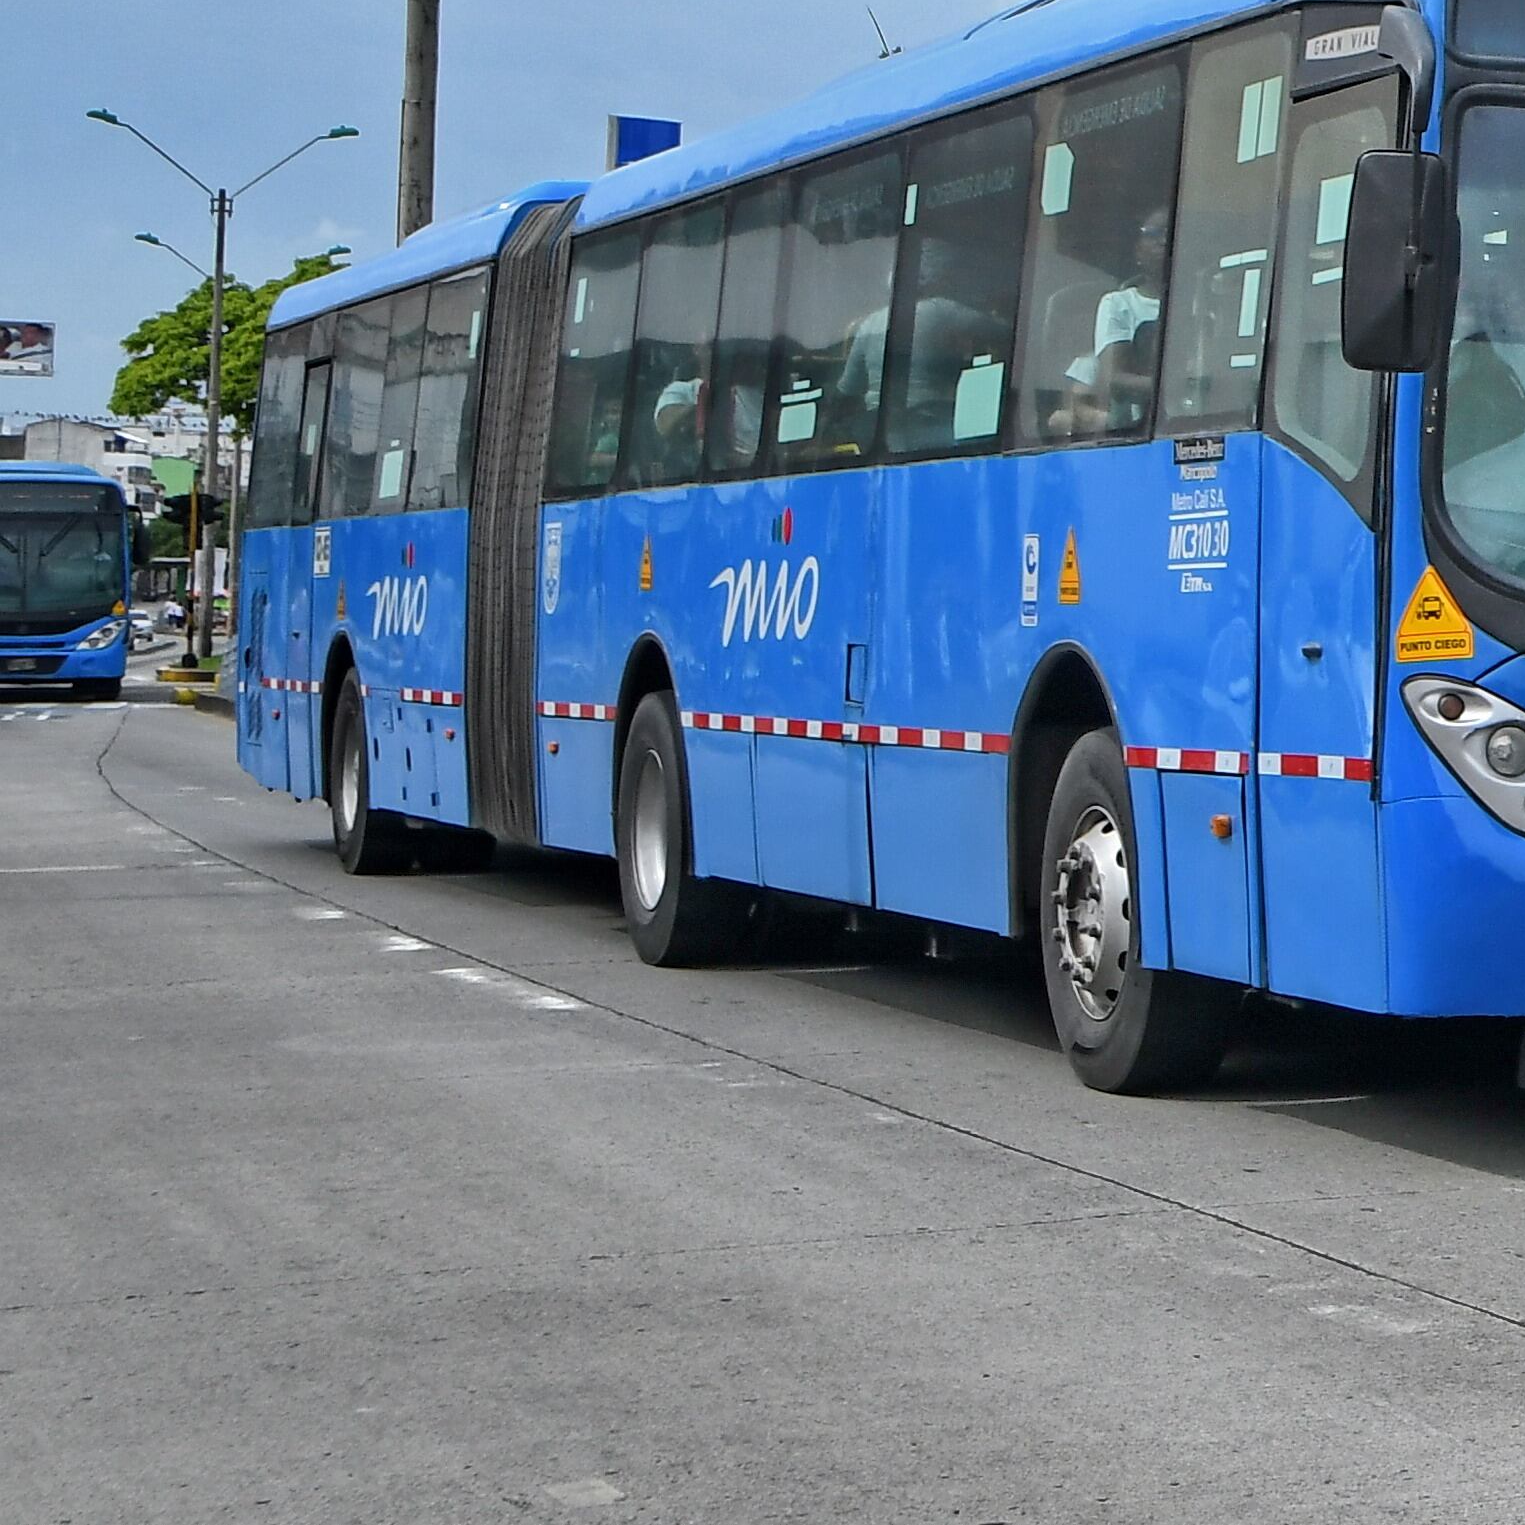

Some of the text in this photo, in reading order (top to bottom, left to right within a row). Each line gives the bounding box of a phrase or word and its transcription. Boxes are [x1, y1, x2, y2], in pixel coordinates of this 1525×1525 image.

[1314, 29, 1376, 56] GRAN VIAL
[1400, 638, 1467, 652] PUNTO CIEGO
